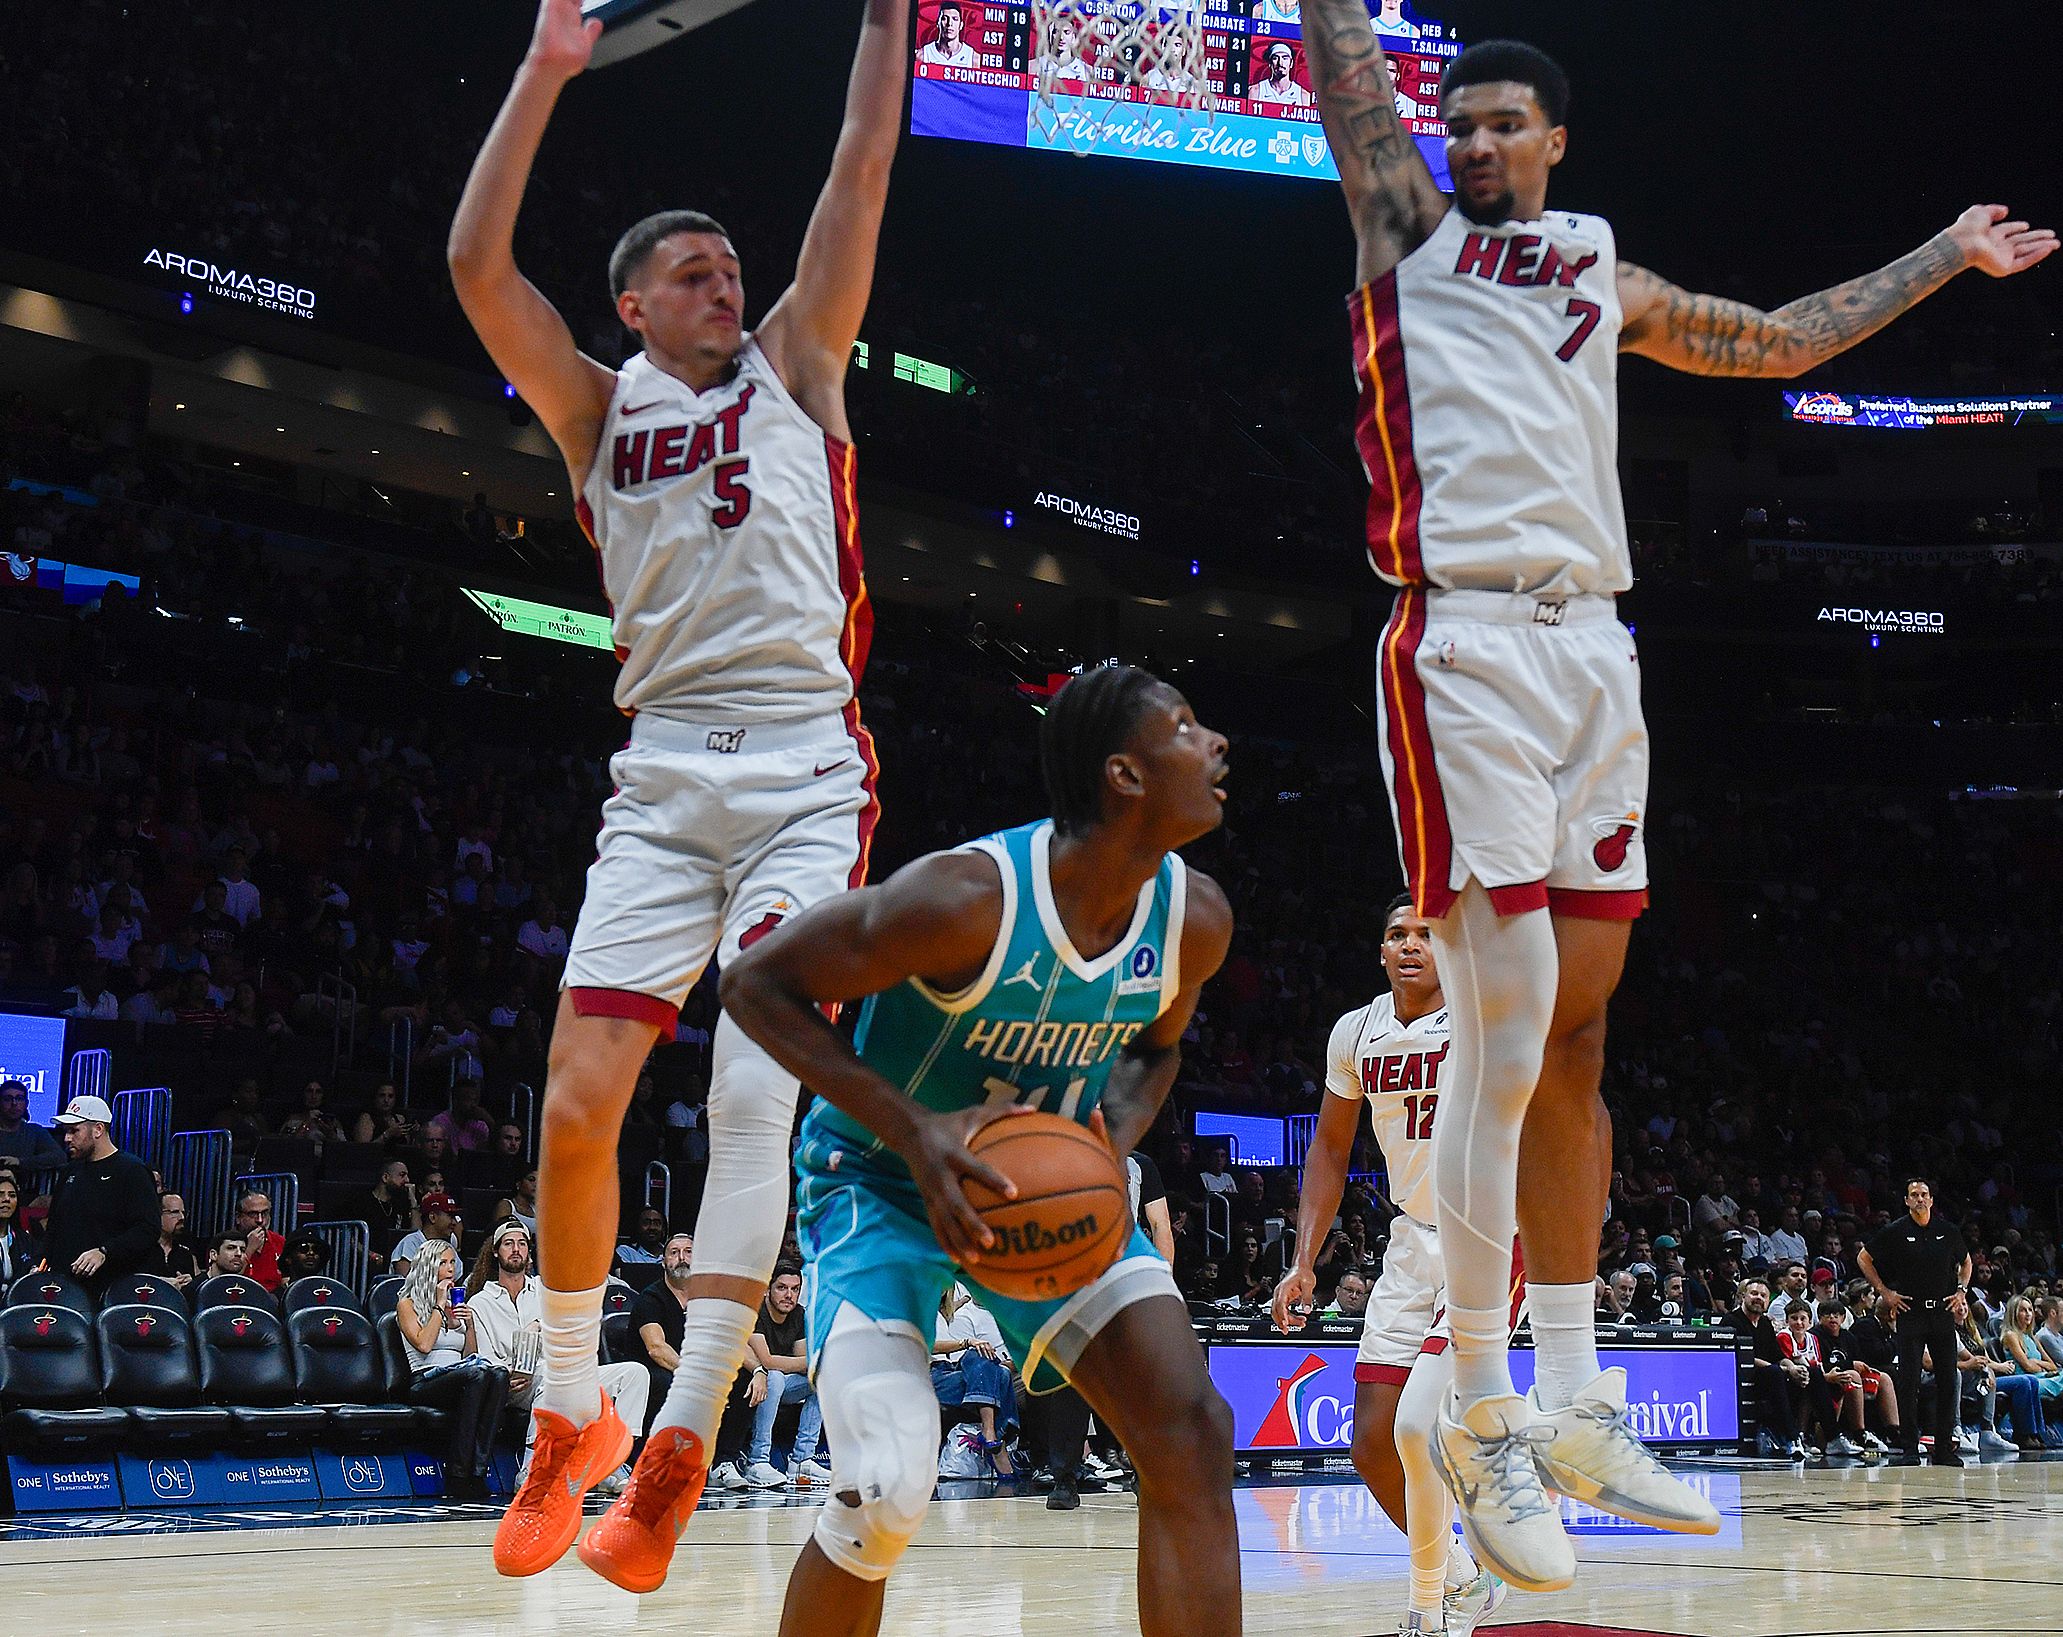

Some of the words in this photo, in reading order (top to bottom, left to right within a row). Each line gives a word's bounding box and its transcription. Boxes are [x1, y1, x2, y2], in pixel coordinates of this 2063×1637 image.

[984, 8, 1006, 23] MIN
[1239, 1, 1244, 14] 1
[1096, 21, 1118, 36] MIN
[1256, 21, 1271, 35] 23
[1421, 23, 1442, 38] REB
[1449, 27, 1457, 40] 4
[983, 30, 1005, 45] AST
[1014, 35, 1021, 47] 3
[1206, 34, 1227, 49] MIN
[1231, 38, 1246, 51] 21
[1125, 47, 1133, 60] 2
[1411, 40, 1458, 57] T.SALAUN
[982, 53, 1003, 68] REB
[1012, 57, 1020, 70] 0
[1205, 57, 1225, 71] AST
[1235, 60, 1242, 73] 1
[1420, 60, 1440, 74] MIN
[920, 65, 928, 77] 0
[943, 67, 1020, 88] S.FONTECCHIO
[1094, 67, 1115, 81] REB
[1089, 84, 1132, 100] N.JOVIC
[1233, 82, 1241, 95] 8
[1418, 82, 1439, 96] AST
[1143, 90, 1151, 103] 7
[1201, 96, 1241, 113] KWARE
[1252, 102, 1263, 116] 11
[1417, 104, 1438, 118] REB
[1050, 110, 1180, 149] Florida
[1184, 127, 1258, 158] Blue
[143, 248, 316, 309] AROMA360
[208, 284, 254, 303] LUXURY
[257, 297, 314, 320] SCENTING
[1555, 298, 1602, 363] 7
[1792, 393, 1854, 417] Acordis
[1859, 400, 1907, 413] Preferred
[1908, 400, 1955, 413] Business
[1956, 401, 2008, 413] Solutions
[2010, 400, 2052, 411] Partner
[1903, 414, 1914, 425] of
[1915, 414, 1934, 425] the
[1935, 413, 1969, 425] Miami
[1970, 412, 2004, 424] HEAT!
[613, 382, 757, 491] HEAT
[713, 460, 752, 529] 5
[1033, 491, 1140, 532] AROMA360
[1073, 517, 1102, 530] LUXURY
[1103, 525, 1139, 540] SCENTING
[1817, 607, 1944, 626] AROMA360
[1864, 623, 1898, 632] LUXURY
[1901, 625, 1945, 634] SCENTING
[963, 1017, 1145, 1068] HORNETS
[1361, 1040, 1450, 1094] HEAT
[1403, 1095, 1439, 1140] 12
[1230, 1154, 1277, 1167] rnival
[1216, 1322, 1250, 1332] ticketmaster
[1322, 1324, 1355, 1333] ticketmaster
[1594, 1330, 1618, 1338] cketmaster
[1632, 1330, 1658, 1339] ticketmaster
[1672, 1331, 1697, 1339] ticketmaster
[1271, 1458, 1304, 1467] ticketmaster
[1323, 1457, 1353, 1466] ticketmaste
[227, 1472, 249, 1482] ONE
[258, 1464, 309, 1478] Sotheby's
[415, 1466, 436, 1476] ONE
[17, 1477, 43, 1488] ONE
[52, 1471, 110, 1484] Sotheby's
